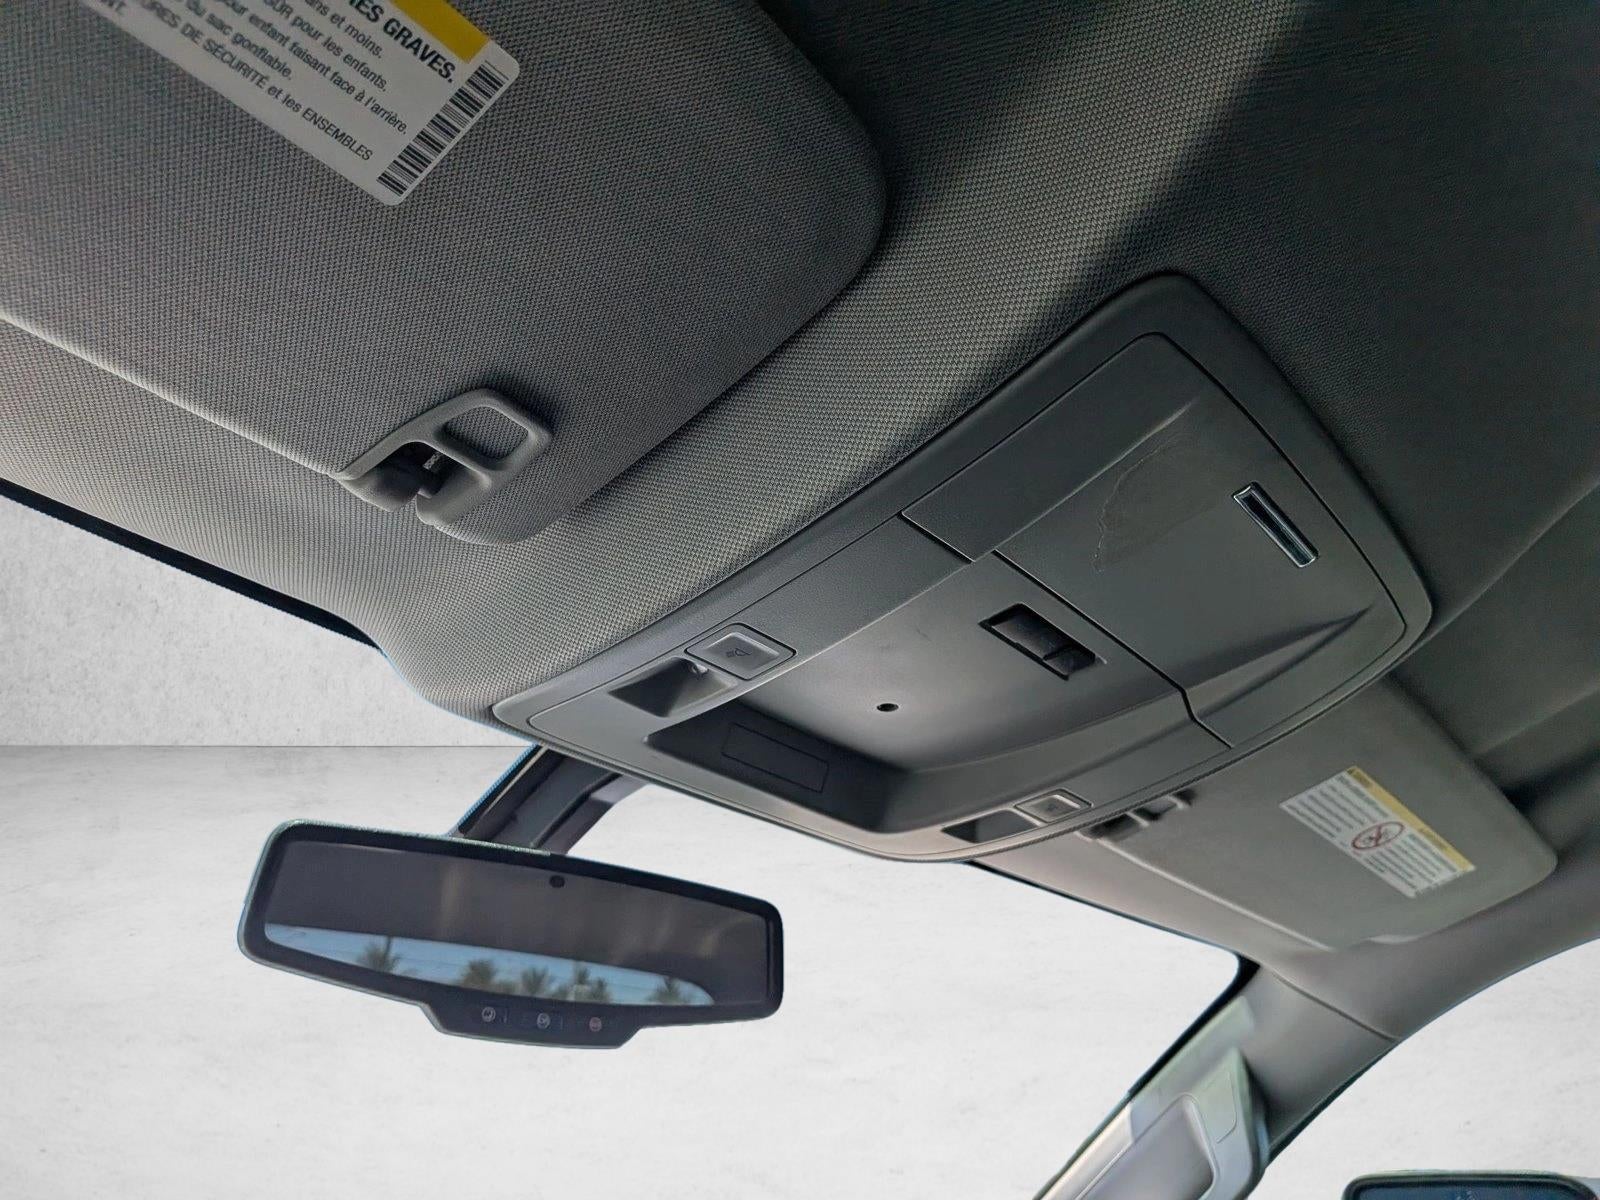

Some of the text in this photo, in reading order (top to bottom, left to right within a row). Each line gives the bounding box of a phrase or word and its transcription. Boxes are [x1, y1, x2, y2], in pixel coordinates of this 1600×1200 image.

[205, 13, 232, 35] sac
[231, 32, 292, 81] gonflable.
[291, 15, 324, 40] pour
[321, 36, 343, 57] les
[342, 53, 387, 91] enfants.
[330, 13, 346, 28] et
[344, 24, 383, 59] moins.
[383, 17, 456, 83] GRAVES.
[181, 22, 203, 45] DE
[203, 38, 270, 89] SÉCURITÉ
[267, 85, 283, 100] et
[282, 94, 302, 112] les
[302, 107, 374, 161] ENSEMBLES
[249, 14, 290, 47] enfant
[289, 42, 331, 77] faisant
[330, 71, 355, 95] face
[354, 88, 366, 102] à
[363, 97, 407, 134] l'arrière.
